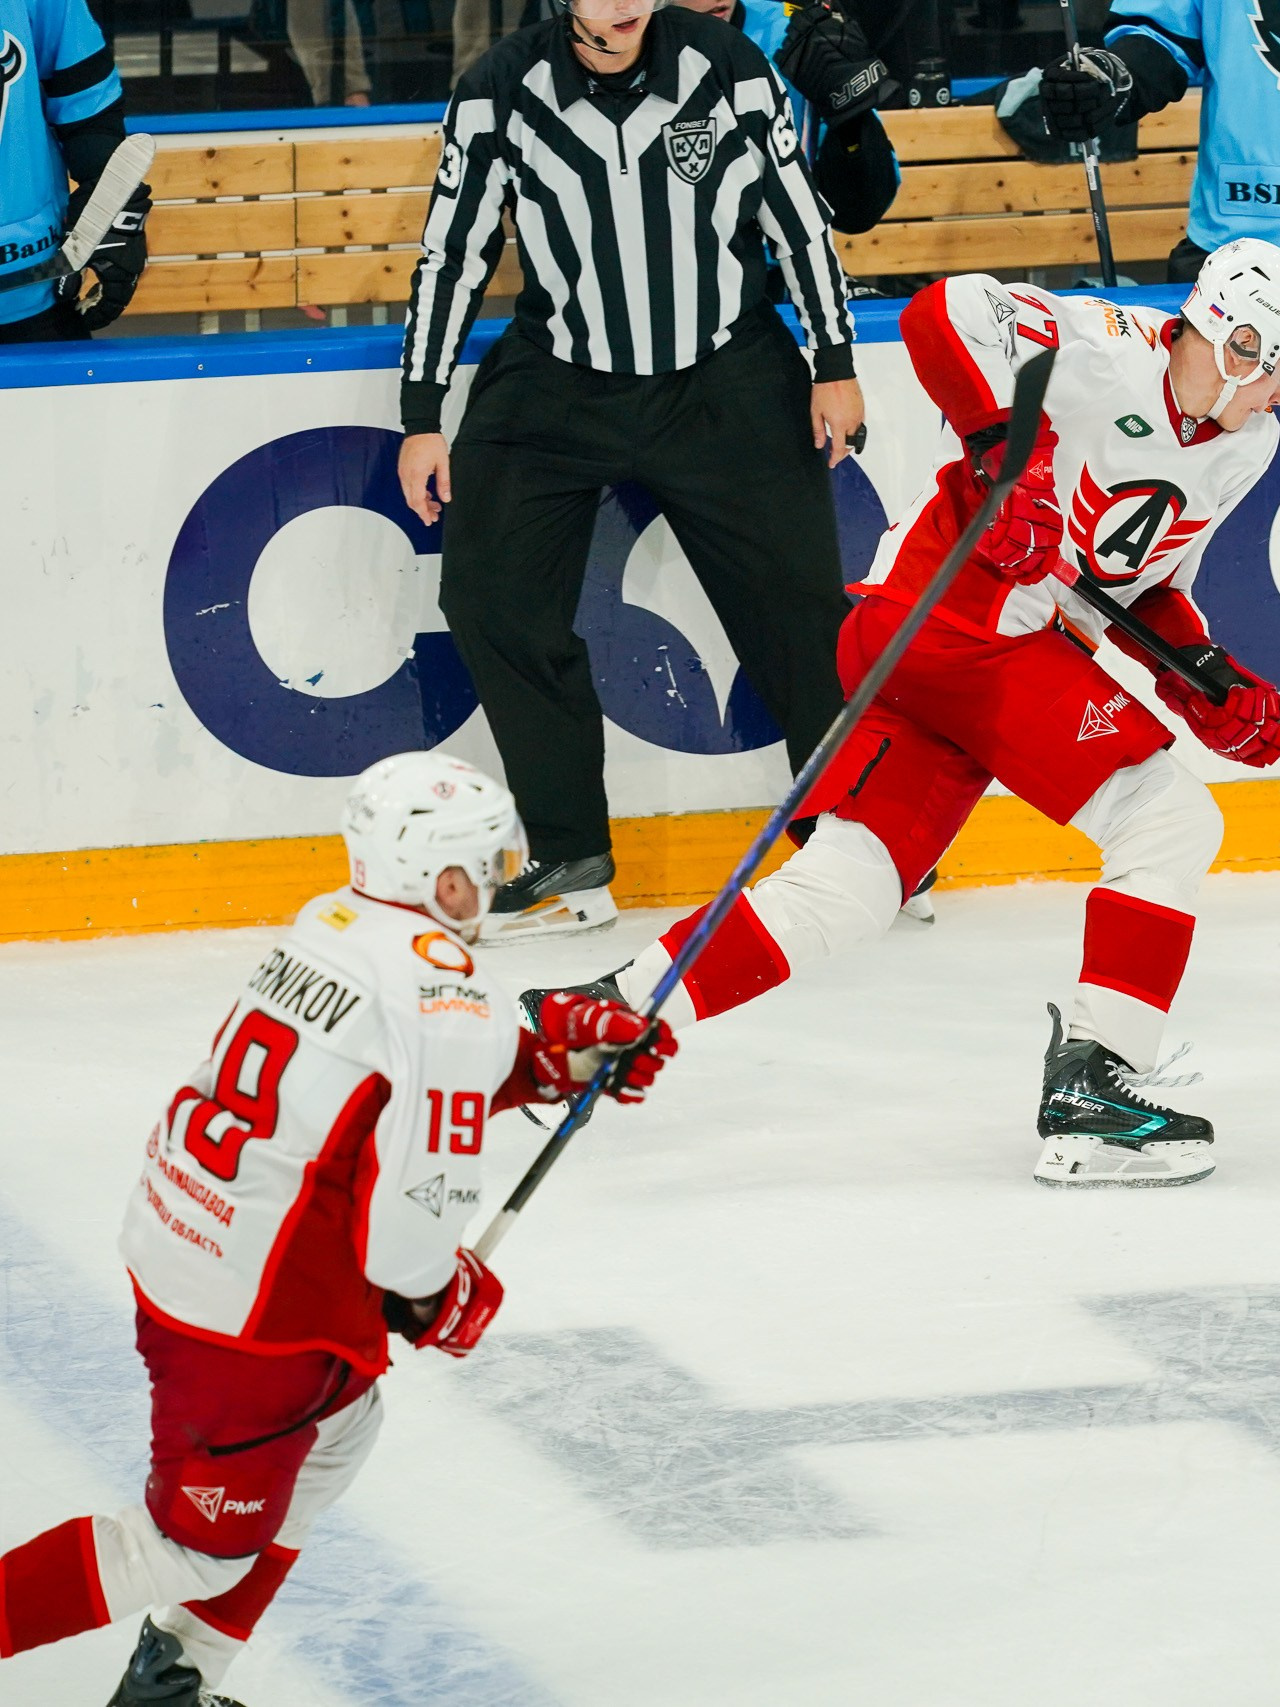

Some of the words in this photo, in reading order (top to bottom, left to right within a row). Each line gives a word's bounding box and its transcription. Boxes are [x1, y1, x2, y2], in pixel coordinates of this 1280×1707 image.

[675, 119, 706, 130] FONBET
[249, 948, 361, 1034] ERNIKOV
[427, 1089, 485, 1155] 19
[1049, 1092, 1105, 1113] BAUER
